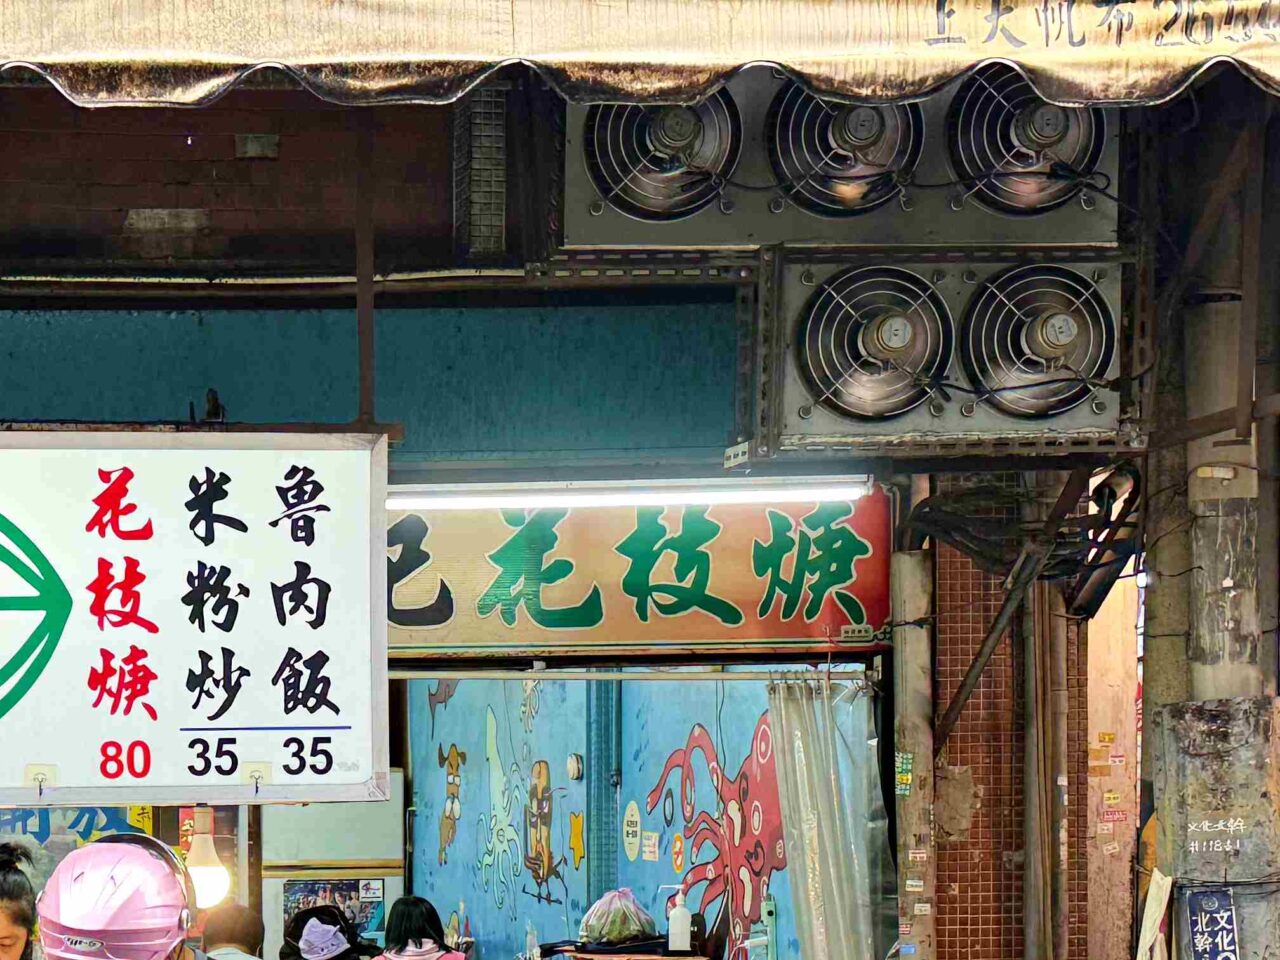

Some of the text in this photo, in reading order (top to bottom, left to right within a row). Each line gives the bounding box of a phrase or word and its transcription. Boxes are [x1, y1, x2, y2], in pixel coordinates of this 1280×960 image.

[180, 466, 251, 722] 米粉炒
[268, 464, 341, 717] 魯肉飯
[99, 740, 151, 780] 80
[187, 737, 239, 777] 35
[282, 736, 334, 776] 35
[1214, 910, 1236, 951] 文化
